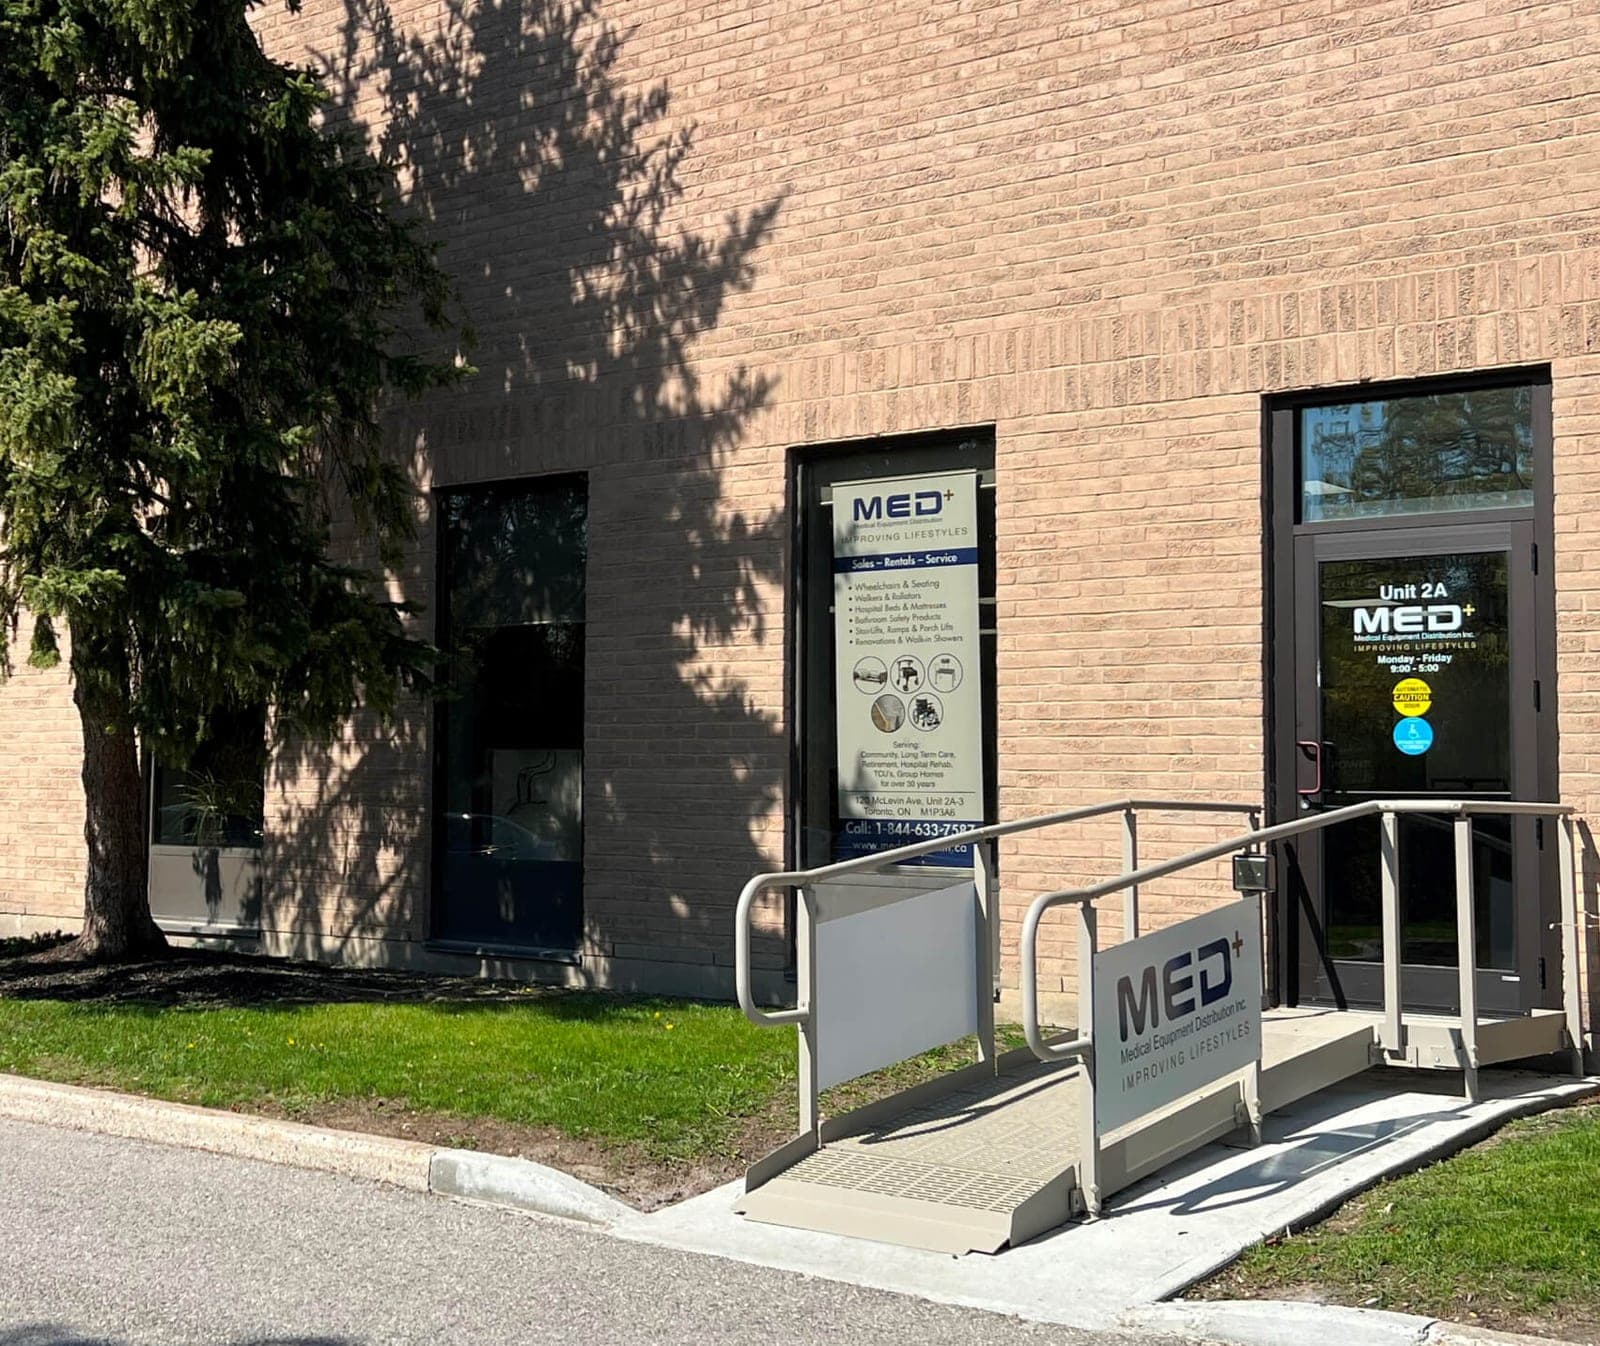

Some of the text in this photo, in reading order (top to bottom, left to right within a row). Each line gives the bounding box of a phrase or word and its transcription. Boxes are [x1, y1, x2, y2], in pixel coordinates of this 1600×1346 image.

[877, 520, 908, 528] Equipment
[841, 527, 968, 545] IMPROVING LIFESTYLES
[852, 559, 874, 569] Sales
[884, 555, 916, 567] Rentals
[925, 552, 958, 564] Service
[855, 580, 940, 591] Wheelchairs & Seating
[1380, 582, 1448, 600] Unit 2A
[855, 593, 882, 601] Walkers
[892, 592, 921, 600] Rollators
[855, 604, 882, 614] Hospital
[885, 604, 900, 612] Beds
[910, 602, 947, 610] Mattresses
[855, 611, 941, 624] Bathroom Safety Products
[887, 625, 909, 634] Ramps
[911, 624, 918, 632] &
[920, 624, 939, 632] Porch
[940, 622, 954, 631] Lifts
[933, 634, 963, 643] Showers
[1382, 633, 1420, 641] Equipment
[1421, 631, 1462, 639] Distribution
[1353, 641, 1477, 652] IMPROVING LIFESTYLES
[1377, 655, 1415, 665] Monday
[1422, 653, 1453, 664] Friday
[1390, 664, 1411, 673] 9:00
[1418, 663, 1440, 672] 5:00
[901, 751, 919, 760] Long
[901, 761, 929, 770] Hospital
[897, 770, 919, 779] Group
[920, 770, 944, 778] Homes
[917, 781, 936, 789] years
[871, 797, 905, 805] McLevin
[926, 797, 943, 806] Unit
[944, 798, 965, 806] 2A-3
[897, 807, 911, 816] ON
[921, 807, 956, 817] M1P3A6
[845, 821, 872, 835] Call:
[1120, 1041, 1152, 1065] Medical
[1153, 1021, 1194, 1052] Equipment
[1195, 1005, 1235, 1033] Distribution
[1121, 1021, 1250, 1093] IMPROVING LIFESTYLES
